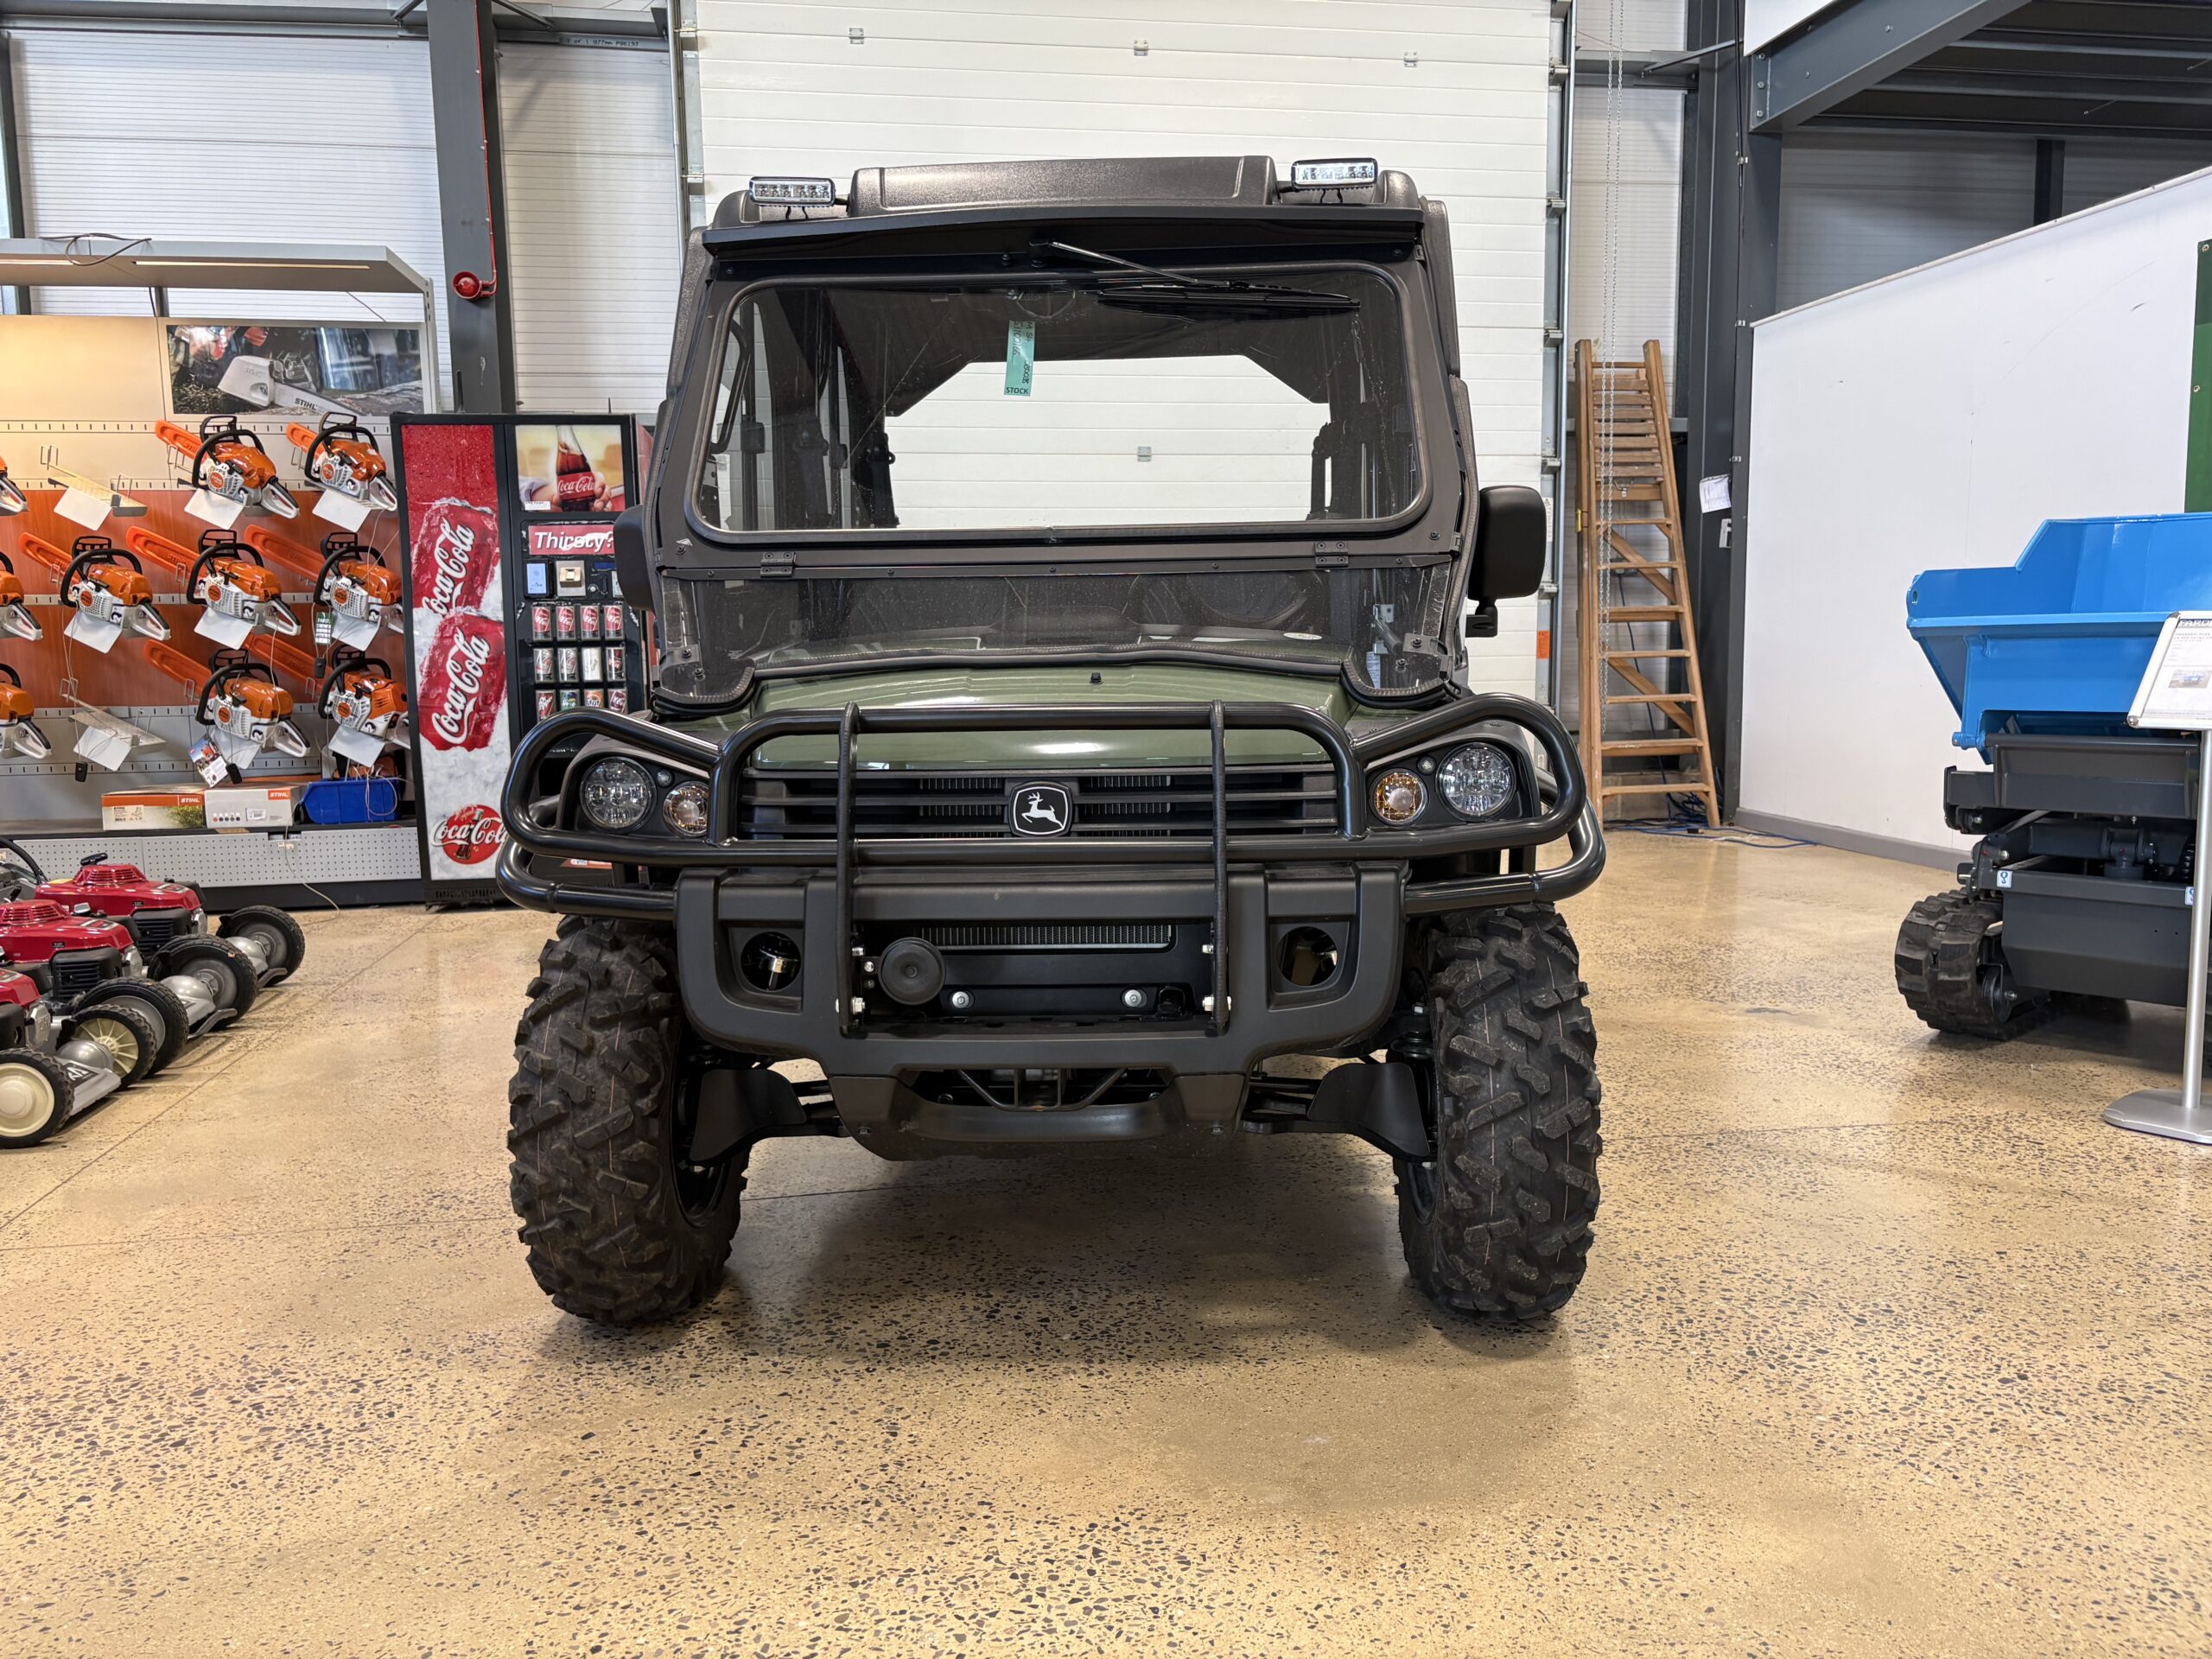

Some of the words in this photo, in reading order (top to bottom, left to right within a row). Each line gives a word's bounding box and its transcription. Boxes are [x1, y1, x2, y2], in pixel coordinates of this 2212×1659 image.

[1005, 386, 1029, 395] STOCK
[294, 397, 318, 411] STIHL
[557, 476, 595, 496] Coca-Cola
[534, 531, 613, 553] Thirsty?
[432, 626, 490, 744] Coca-Cola
[431, 817, 508, 848] Coca-Col
